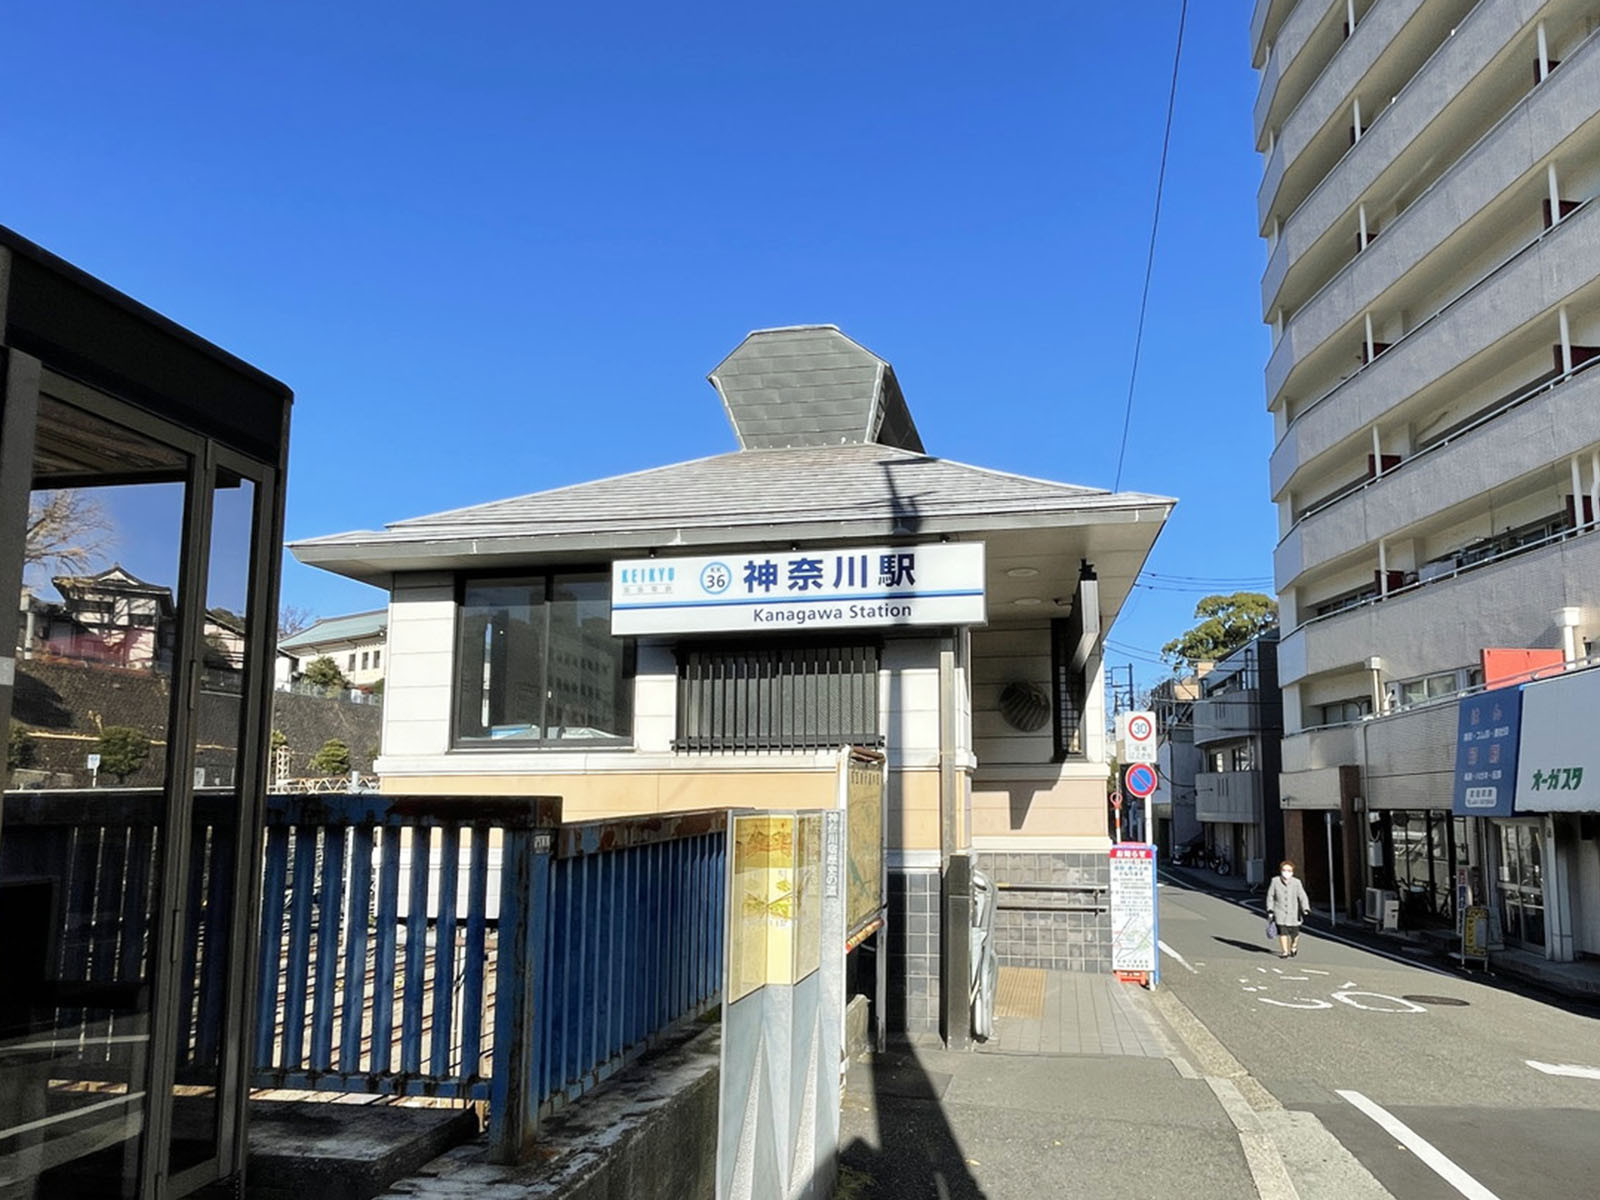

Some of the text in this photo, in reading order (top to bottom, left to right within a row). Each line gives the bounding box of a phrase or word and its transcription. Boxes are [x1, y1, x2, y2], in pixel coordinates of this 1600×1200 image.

[621, 567, 676, 583] KEIKYU
[706, 574, 726, 589] 36
[743, 553, 916, 593] 神奈川駅
[753, 603, 912, 625] Kanagawa Station
[1134, 722, 1147, 734] 30
[1531, 767, 1583, 791] オーガスタ
